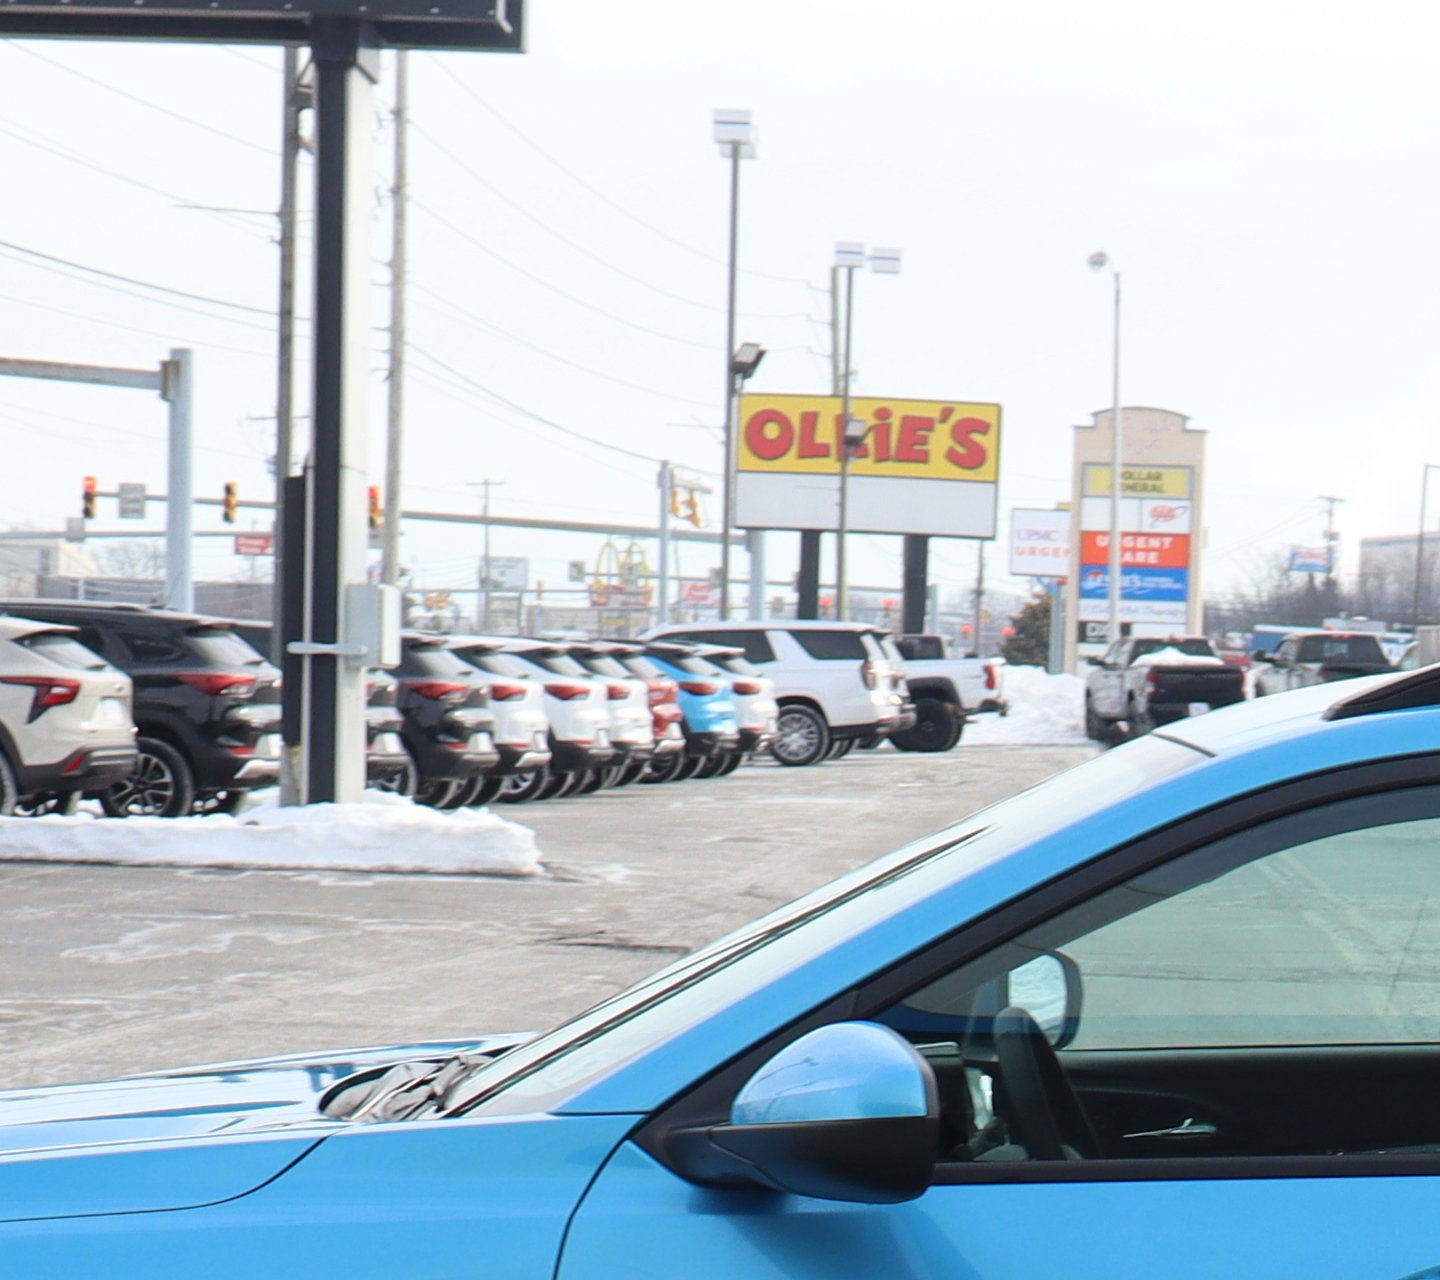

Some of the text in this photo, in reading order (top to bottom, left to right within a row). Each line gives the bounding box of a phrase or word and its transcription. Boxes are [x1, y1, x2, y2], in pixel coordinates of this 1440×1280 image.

[1120, 470, 1163, 482] OLLAR
[1096, 535, 1173, 549] UGENT
[1121, 551, 1160, 564] ARE
